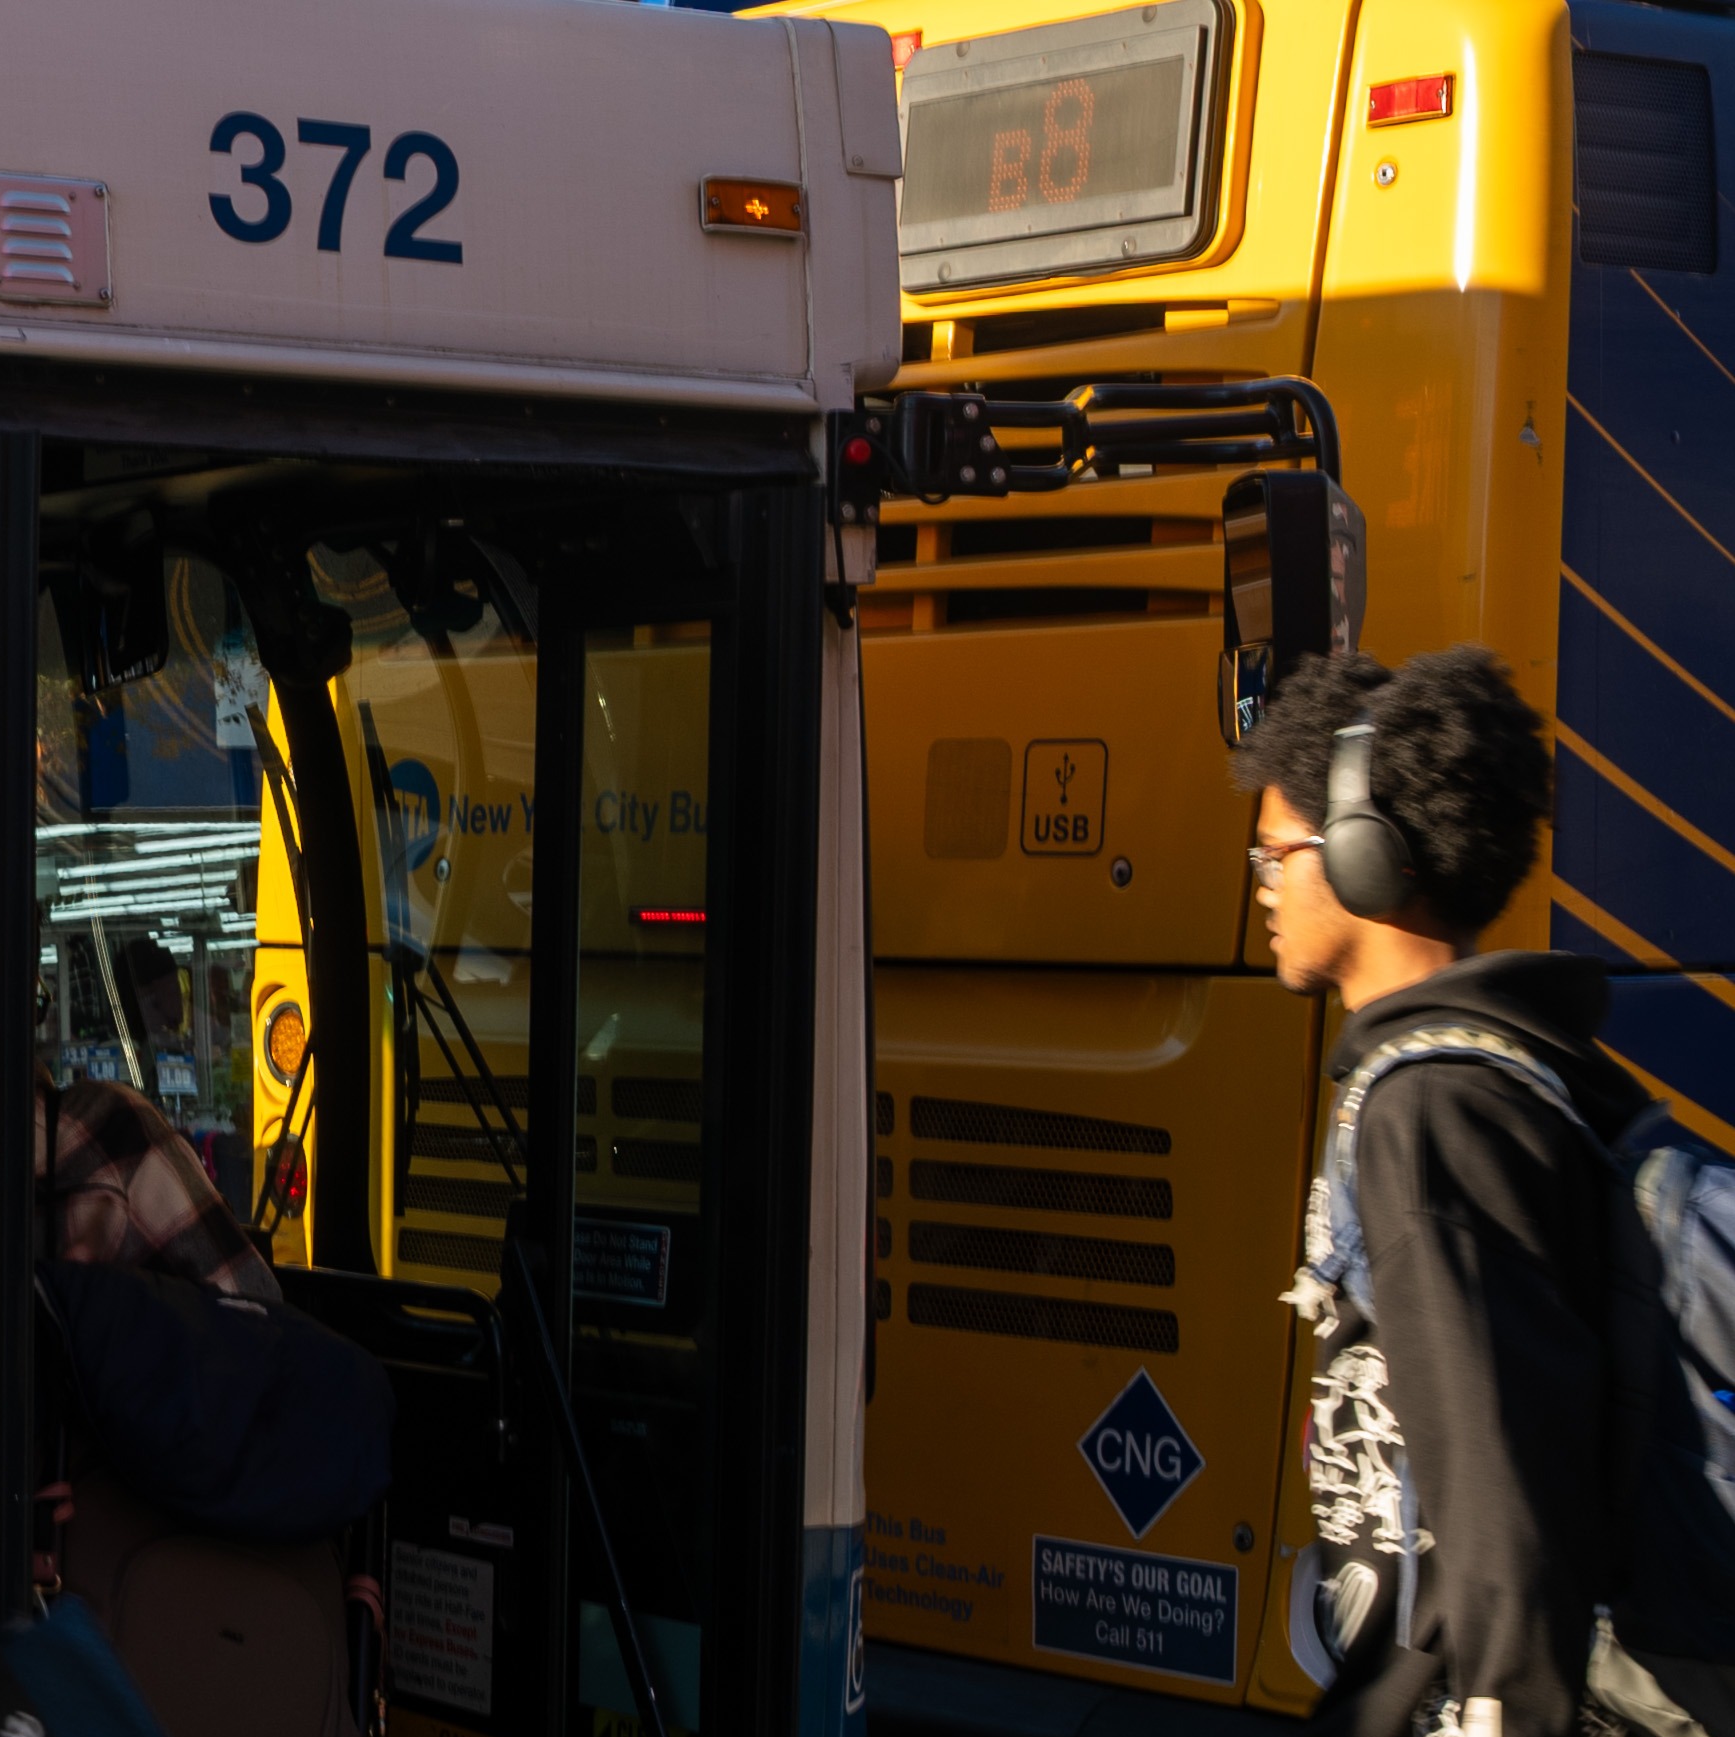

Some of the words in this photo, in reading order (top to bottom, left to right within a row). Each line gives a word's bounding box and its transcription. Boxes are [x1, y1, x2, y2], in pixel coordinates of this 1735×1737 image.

[989, 78, 1096, 213] B8
[208, 110, 463, 264] 372
[449, 794, 512, 835] New
[595, 791, 660, 842] City
[670, 791, 709, 833] Bu
[1034, 814, 1090, 843] USB
[629, 1233, 658, 1253] Stand
[1096, 1428, 1183, 1481] CNG
[867, 1510, 903, 1537] This
[910, 1518, 946, 1544] Bus
[864, 1545, 909, 1573] Uses
[916, 1553, 1005, 1589] Clean-Air
[1041, 1548, 1125, 1587] SAFETY'S
[1131, 1562, 1170, 1595] OUR
[1176, 1570, 1227, 1604] GOAL
[864, 1577, 974, 1622] Technology
[1040, 1578, 1080, 1607] How
[1086, 1587, 1116, 1614] Are
[1122, 1592, 1152, 1621] We
[1158, 1598, 1225, 1637] Doing?
[1095, 1619, 1130, 1649] Call
[1136, 1627, 1164, 1655] 511
